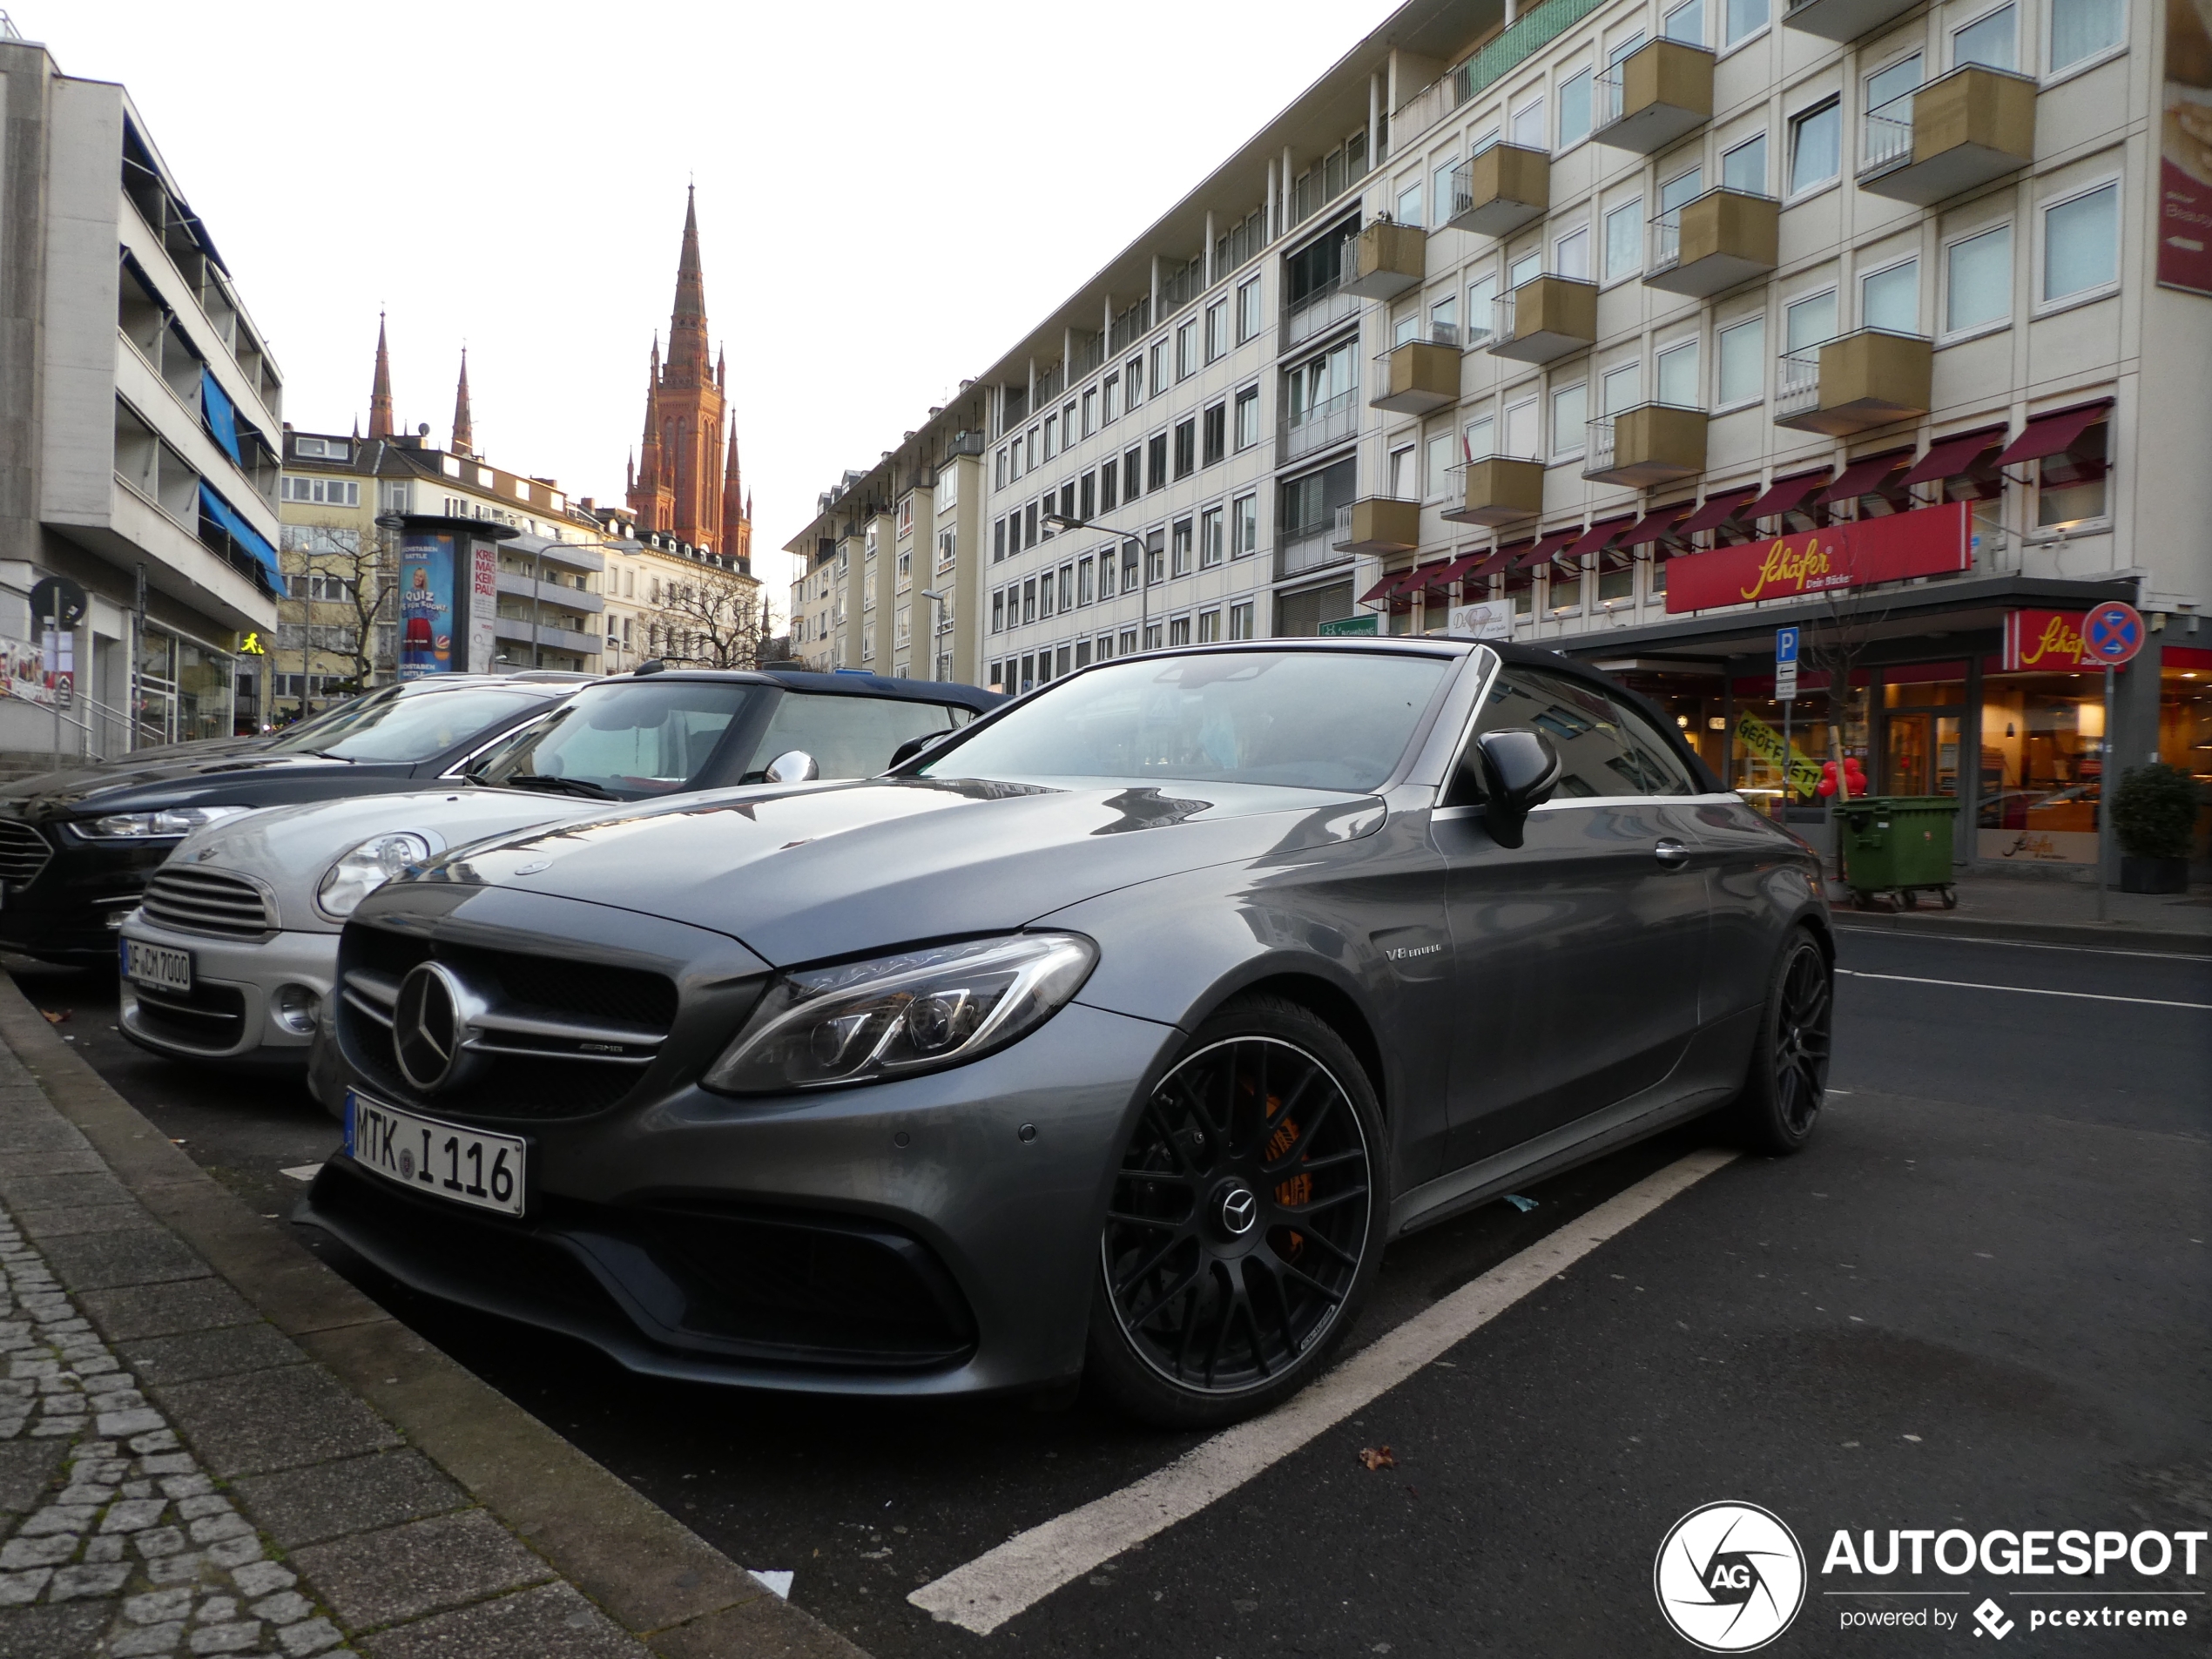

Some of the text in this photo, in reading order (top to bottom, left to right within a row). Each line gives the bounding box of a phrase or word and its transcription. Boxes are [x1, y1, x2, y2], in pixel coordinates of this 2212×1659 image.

[1741, 538, 1830, 599] Schäfer
[406, 590, 434, 602] QUIZ
[1781, 633, 1794, 658] P
[160, 951, 189, 985] 7000
[1386, 947, 1406, 961] V8
[355, 1102, 514, 1203] MTK I 116
